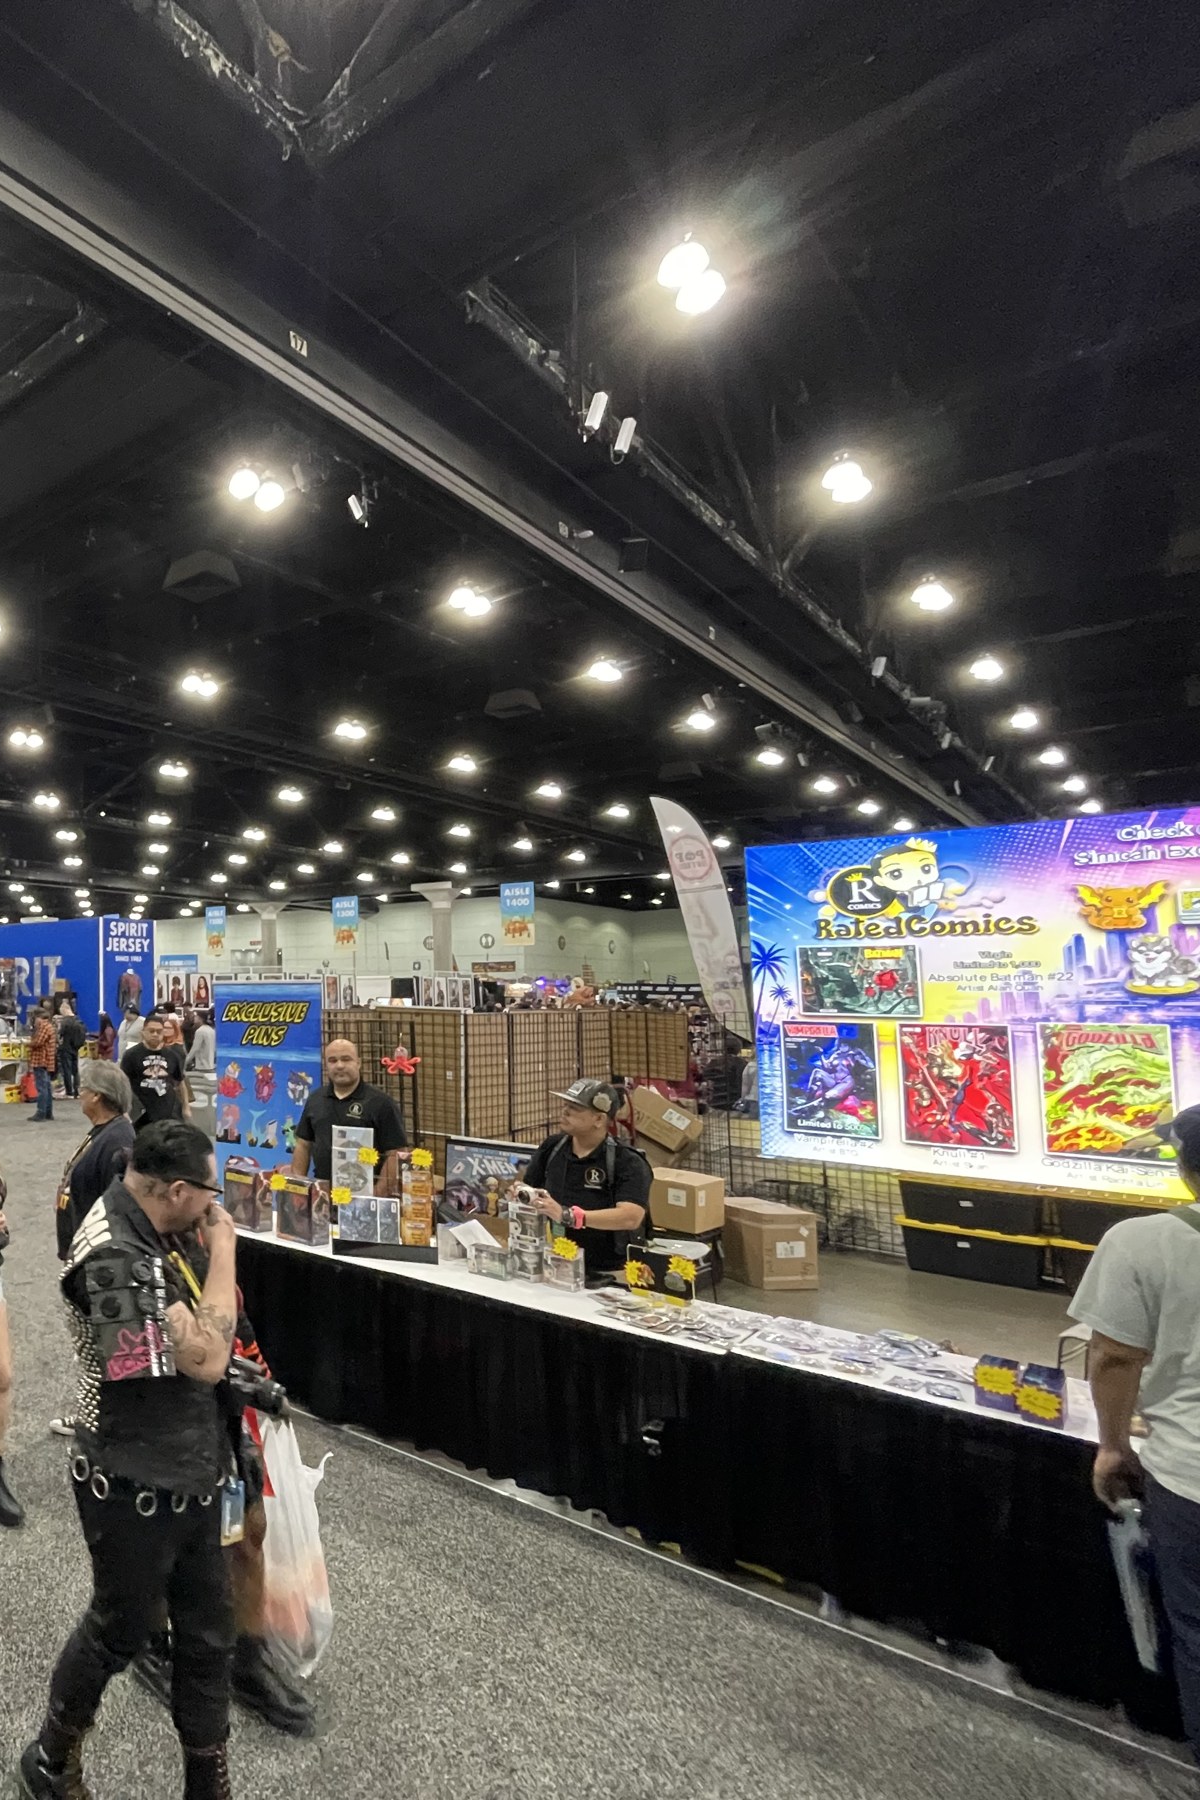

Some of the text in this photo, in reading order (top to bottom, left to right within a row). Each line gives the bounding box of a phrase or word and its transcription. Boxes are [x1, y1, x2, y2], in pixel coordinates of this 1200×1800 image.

[1117, 822, 1194, 841] Check
[504, 887, 530, 896] AISLE
[849, 877, 881, 903] R
[506, 897, 530, 906] 1400
[110, 921, 148, 937] SPIRIT
[106, 937, 150, 952] JERSEY
[978, 951, 1013, 960] Virgin
[953, 961, 995, 969] Limited
[1009, 961, 1041, 970] 1,000
[14, 956, 62, 997] RIT
[928, 972, 1074, 982] Absolute Batman #22
[221, 1001, 311, 1023] EXCLUSIVE
[241, 1024, 289, 1047] PINS
[925, 1026, 985, 1050] KNULL
[1065, 1031, 1158, 1049] GODZILLA
[797, 1119, 831, 1129] Limited
[833, 1121, 843, 1130] to
[795, 1134, 857, 1148] Vampirella
[933, 1148, 967, 1159] Knull
[1041, 1157, 1102, 1172] Godzilla
[1106, 1164, 1165, 1177] Kai-Sen
